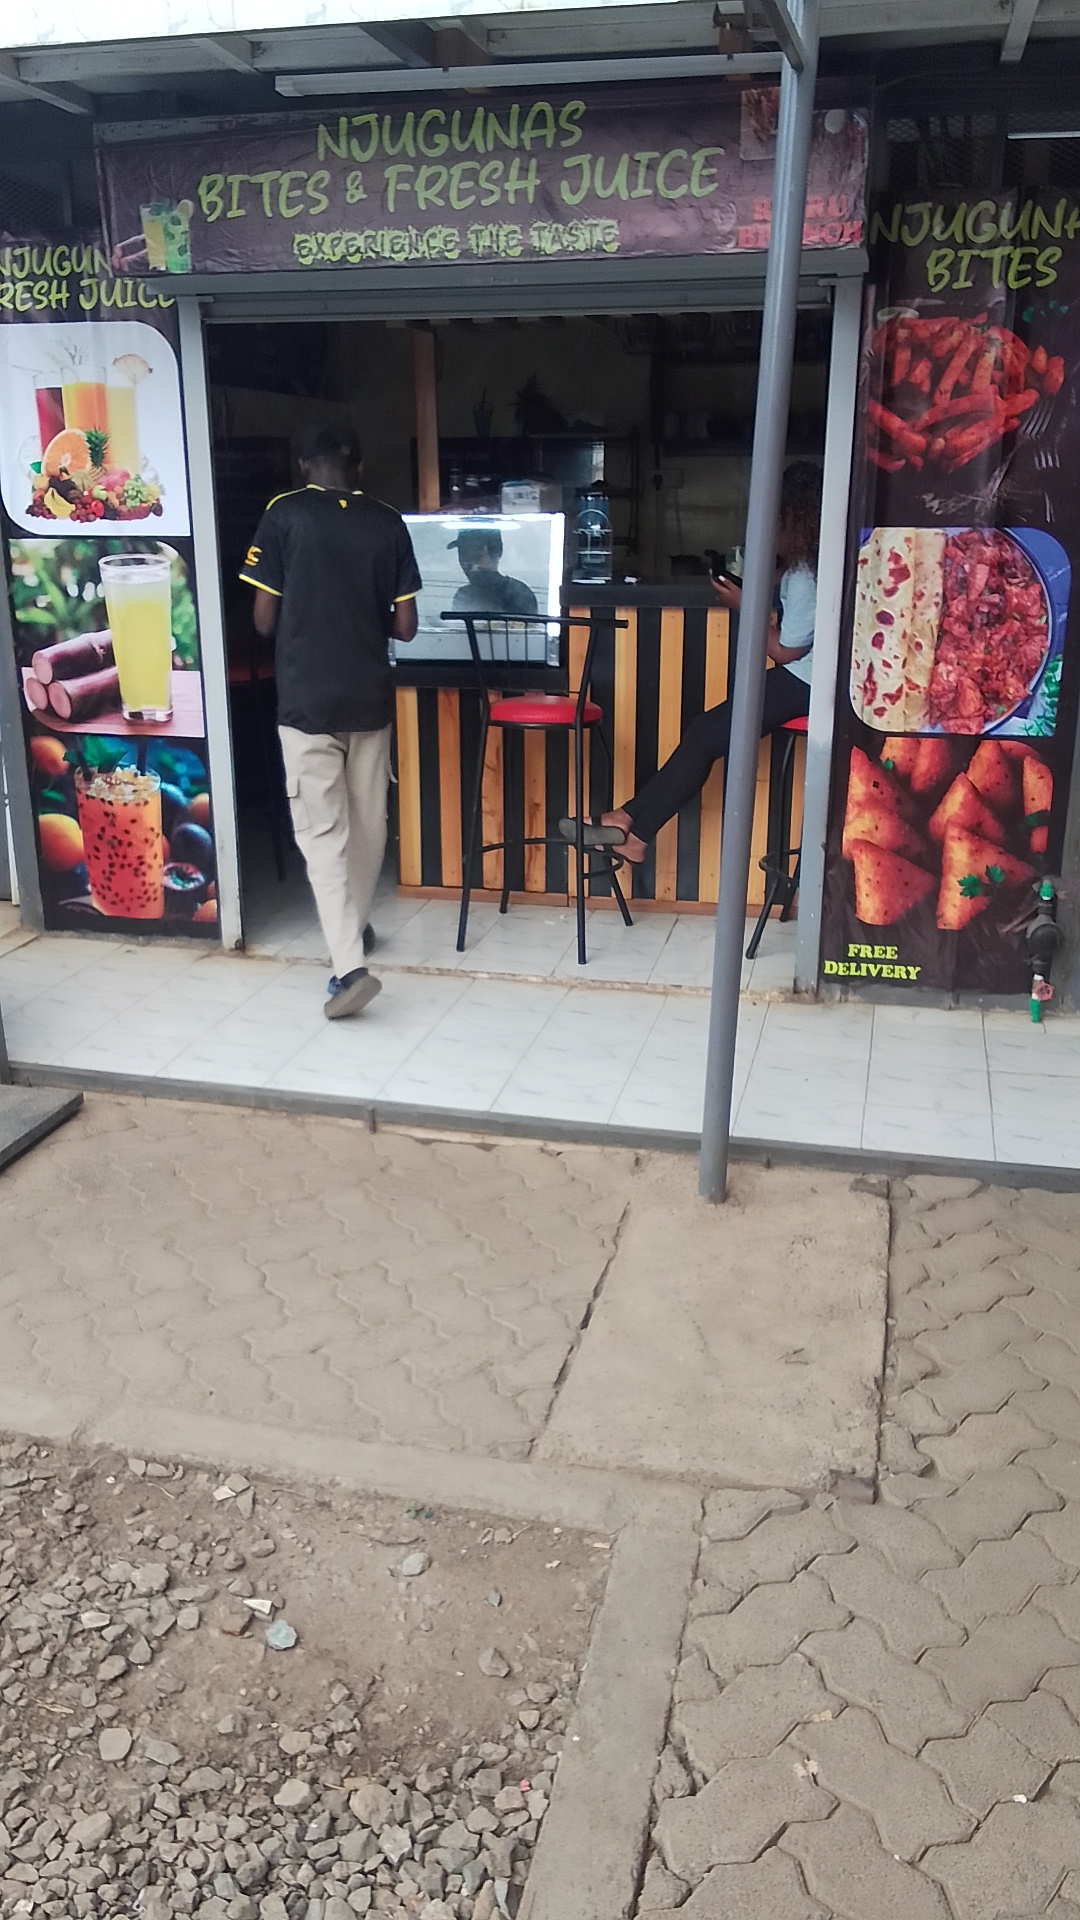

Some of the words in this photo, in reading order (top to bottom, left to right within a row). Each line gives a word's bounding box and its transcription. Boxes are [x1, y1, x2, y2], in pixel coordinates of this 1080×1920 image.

[317, 100, 586, 162] NJUGUNAS
[198, 169, 331, 223] BITES
[346, 170, 368, 204] &
[384, 156, 541, 213] FRESH
[560, 147, 725, 206] JUICE
[294, 226, 459, 264] EXPERIENCE
[467, 221, 522, 257] THE
[529, 218, 619, 253] TASTE
[926, 246, 1062, 293] BITES
[824, 960, 921, 980] DELIVERY
[847, 943, 898, 960] FREE
